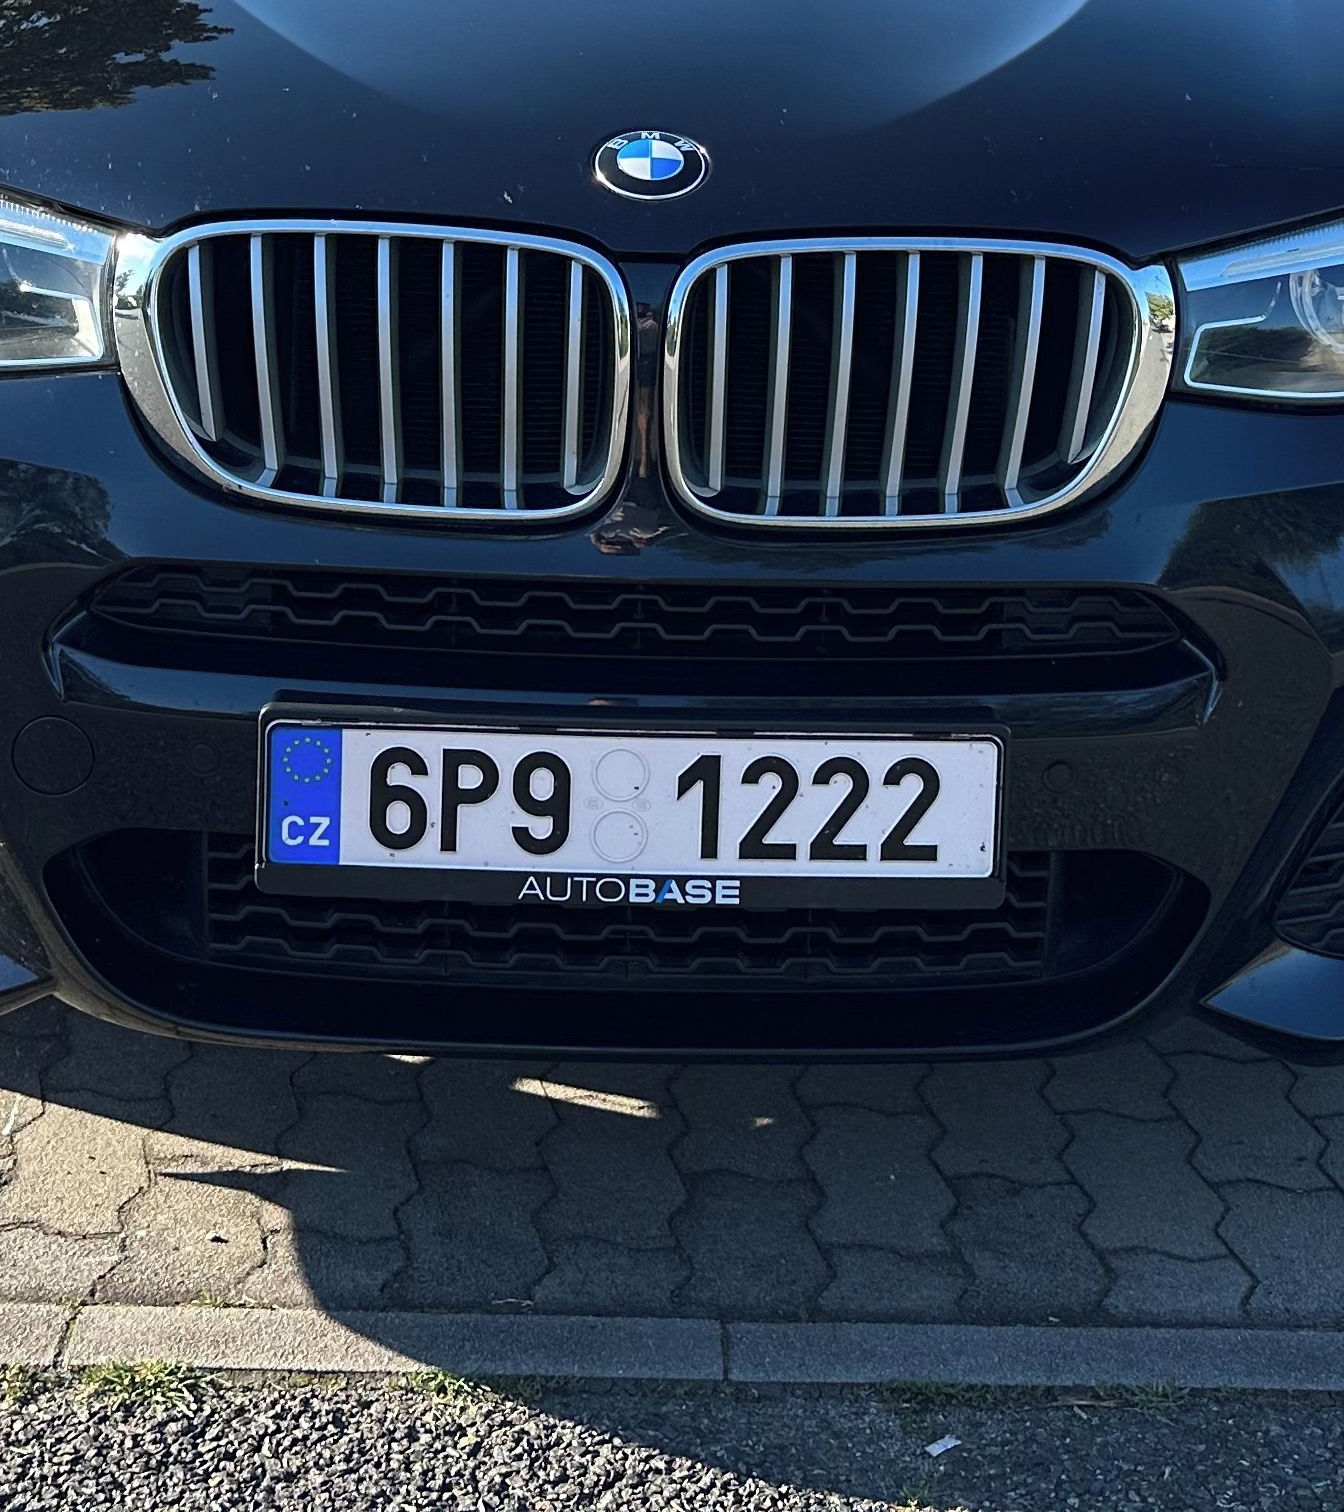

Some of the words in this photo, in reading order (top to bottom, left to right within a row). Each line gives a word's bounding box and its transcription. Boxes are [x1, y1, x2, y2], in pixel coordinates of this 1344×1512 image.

[607, 131, 695, 152] BMW
[369, 746, 572, 856] 6P9
[676, 754, 941, 862] 1222
[281, 814, 331, 847] CZ
[518, 876, 742, 904] AUTOBASE
